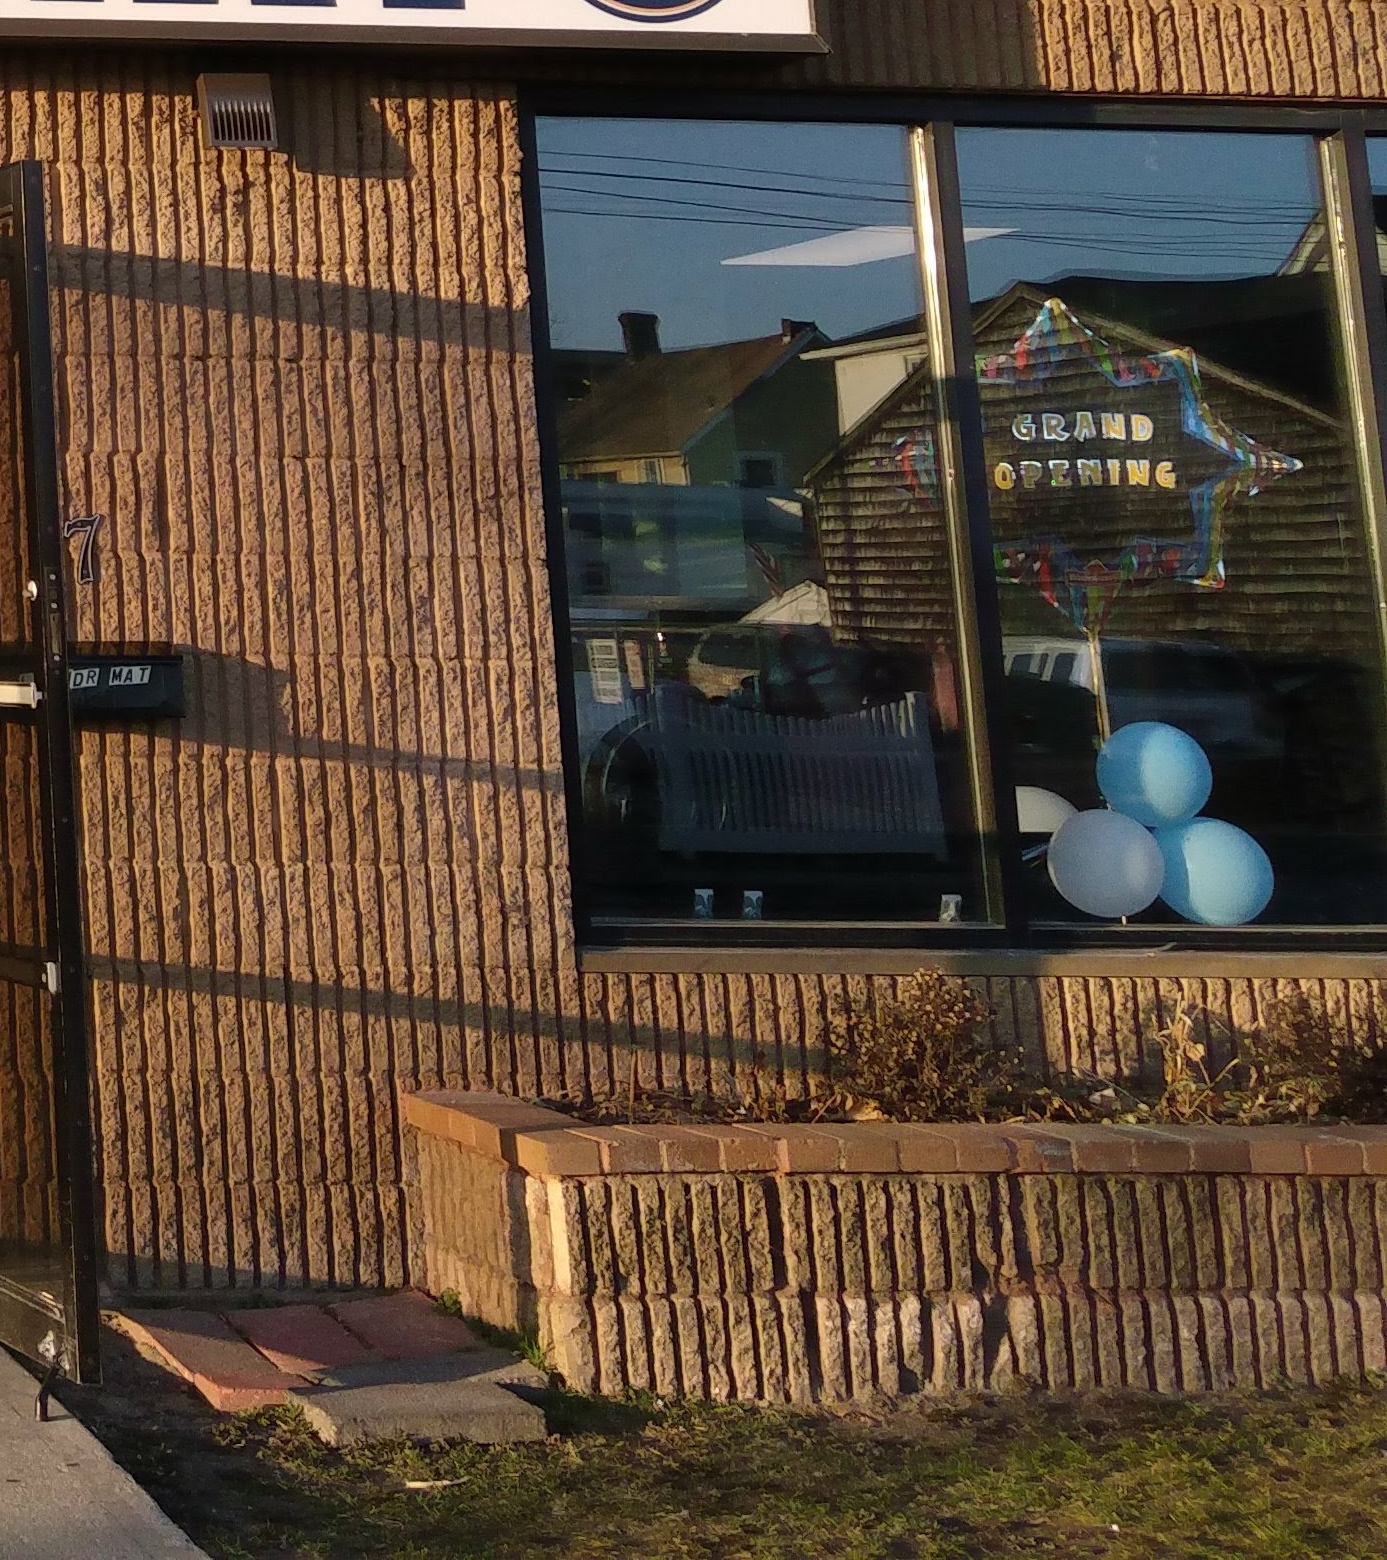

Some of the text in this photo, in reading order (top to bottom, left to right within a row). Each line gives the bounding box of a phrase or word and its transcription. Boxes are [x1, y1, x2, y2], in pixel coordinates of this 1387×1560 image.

[1011, 411, 1154, 443] GRAND
[993, 458, 1177, 490] OPENING
[64, 512, 102, 585] 7
[69, 665, 149, 688] DR MAT
